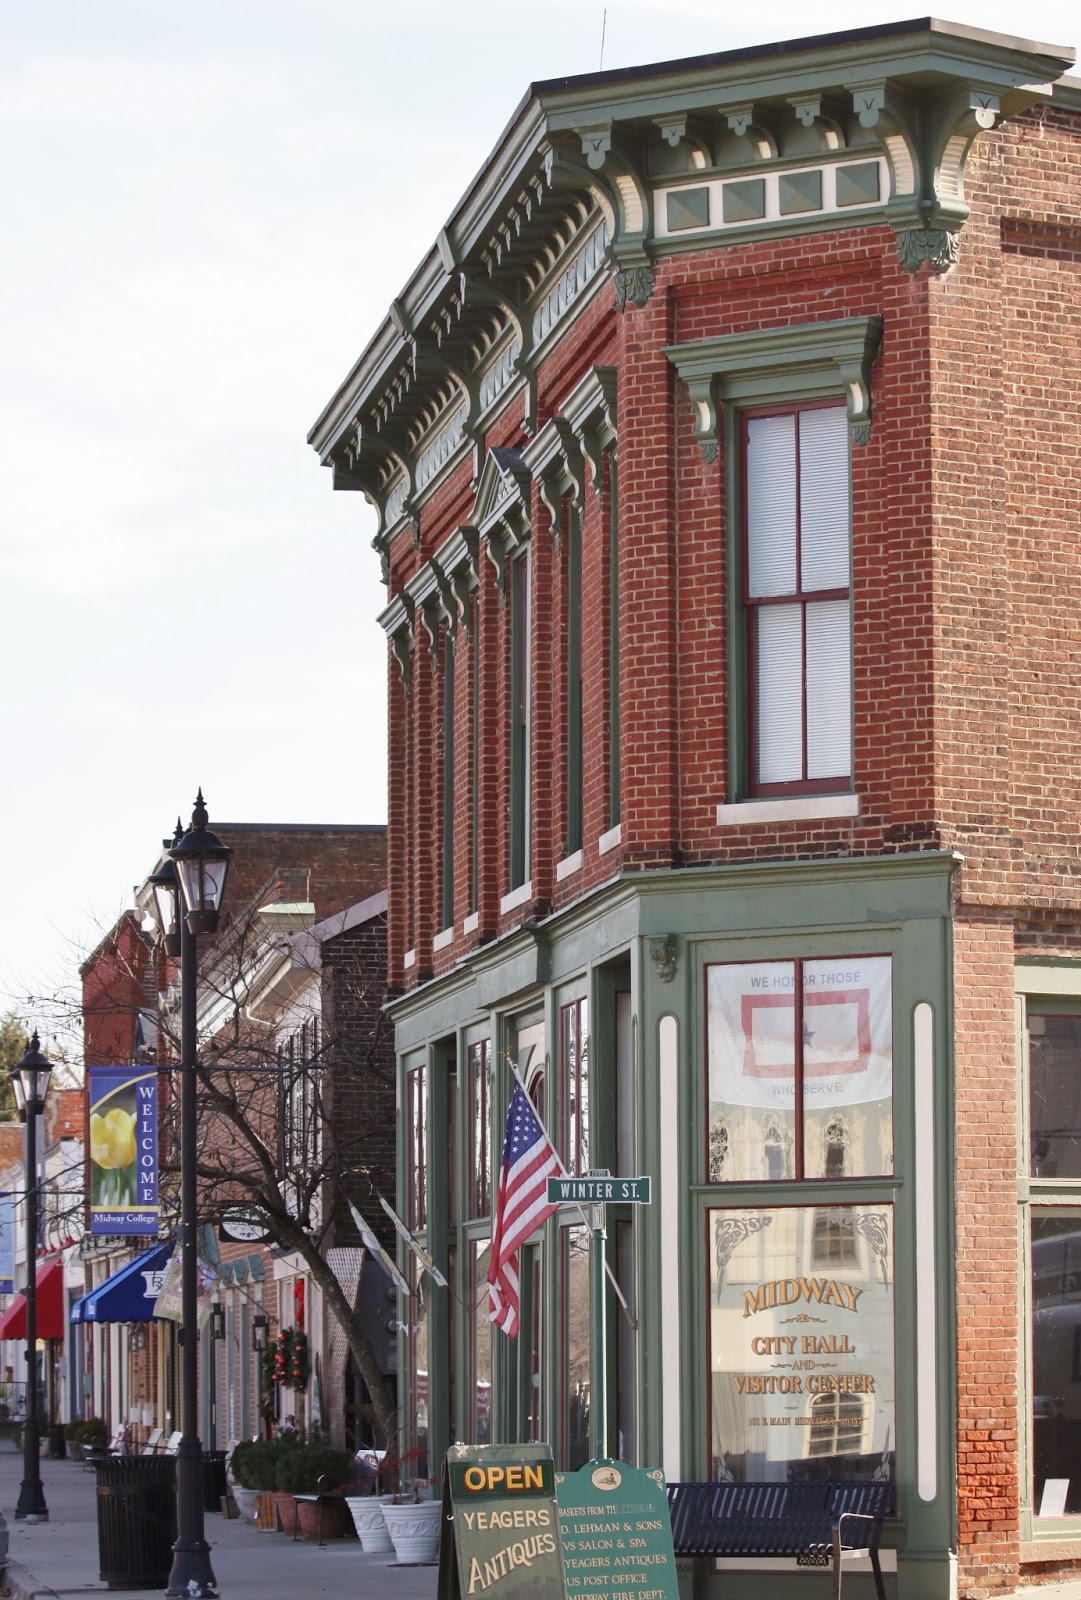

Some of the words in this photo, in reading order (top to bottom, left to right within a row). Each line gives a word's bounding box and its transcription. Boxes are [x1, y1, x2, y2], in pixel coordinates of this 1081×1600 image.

[751, 976, 769, 988] WE
[820, 972, 861, 984] THOSE
[803, 1082, 843, 1094] SERVE
[139, 1086, 155, 1201] WELCOME
[560, 1183, 612, 1198] WINTER
[622, 1183, 640, 1198] ST.
[94, 1214, 125, 1224] Midway
[743, 1277, 863, 1318] MIDWAY
[751, 1336, 798, 1355] CITY
[801, 1335, 856, 1354] HALL
[792, 1360, 816, 1370] AND
[733, 1376, 803, 1394] VISITOR
[805, 1375, 876, 1393] CENTER
[464, 1465, 543, 1491] OPEN
[559, 1508, 586, 1516] BASKETS
[587, 1506, 604, 1515] FROM
[464, 1510, 550, 1530] YEAGERS
[560, 1526, 571, 1534] D.
[574, 1523, 620, 1534] LEHMAN
[624, 1522, 632, 1531] &
[636, 1521, 662, 1530] SONS
[579, 1540, 612, 1550] SALON
[617, 1540, 625, 1548] &
[630, 1539, 647, 1548] SPA
[468, 1534, 556, 1594] ANTIQUES
[565, 1558, 610, 1568] YEAGERS
[614, 1555, 667, 1566] ANTIQUES
[584, 1576, 608, 1586] POST
[612, 1574, 648, 1584] OFFICE
[612, 1592, 634, 1600] FIRE
[638, 1590, 666, 1600] DEPT.
